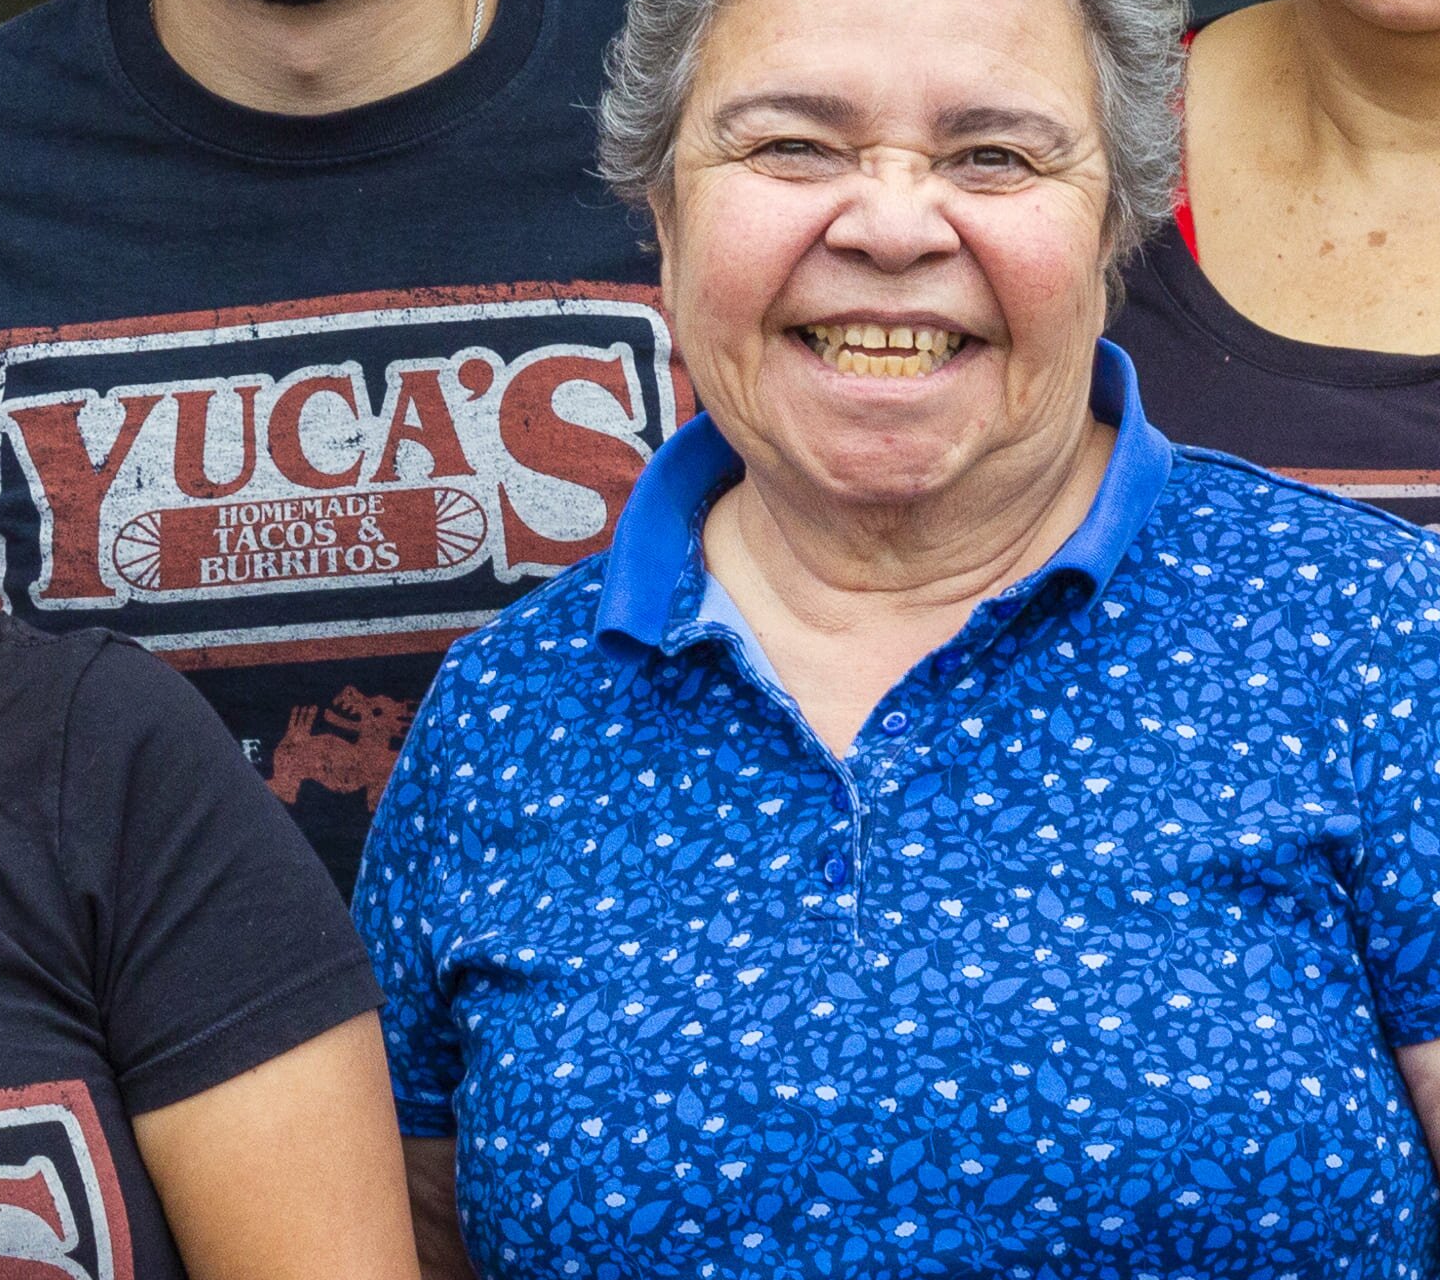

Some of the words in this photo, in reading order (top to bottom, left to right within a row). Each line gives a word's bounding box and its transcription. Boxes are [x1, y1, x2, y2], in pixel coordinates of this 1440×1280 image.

[0, 343, 650, 610] YUCA'S
[218, 493, 385, 525] HOMEMADE
[213, 518, 337, 555] TACOS
[359, 517, 385, 543] &
[199, 542, 401, 586] BURRITOS
